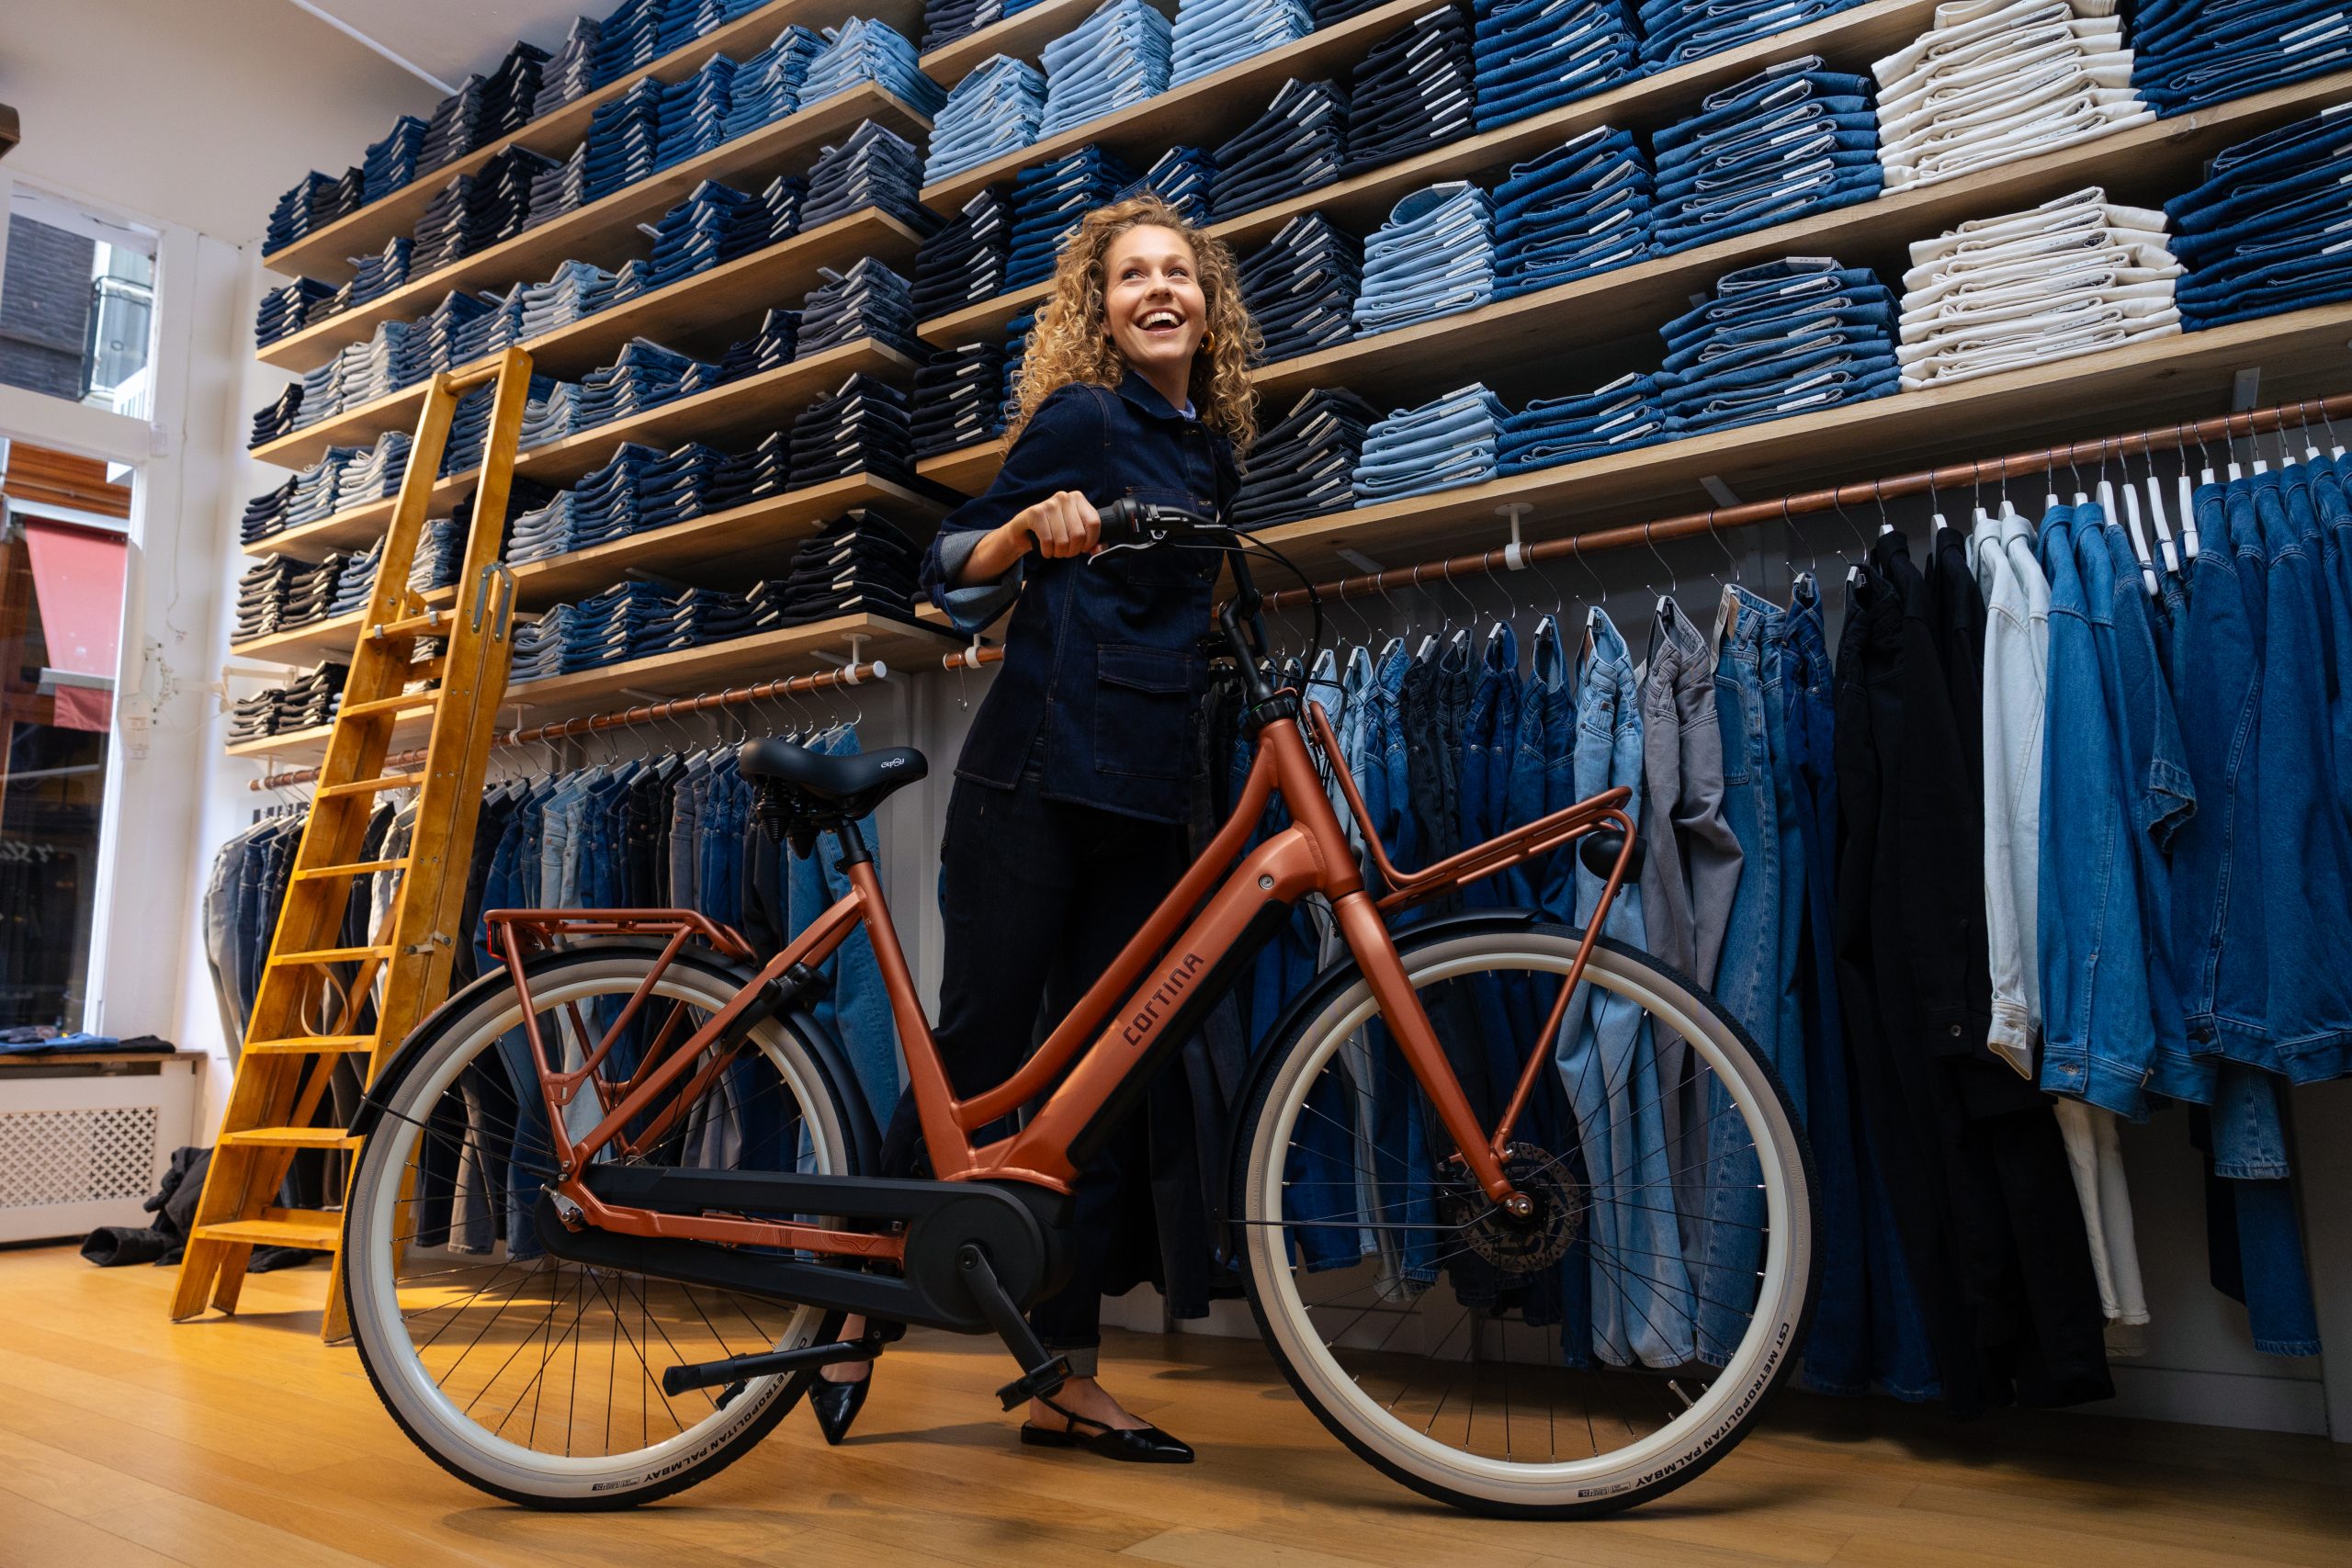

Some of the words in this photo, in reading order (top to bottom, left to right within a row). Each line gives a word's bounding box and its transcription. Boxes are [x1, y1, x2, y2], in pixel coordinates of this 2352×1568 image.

[1122, 953, 1204, 1047] CORTINA
[1776, 1322, 1790, 1349] CST
[710, 1371, 788, 1450] ETROPOLITAN
[1703, 1350, 1779, 1450] METROPOLITAN
[643, 1447, 708, 1483] PALMBAY
[1635, 1446, 1702, 1487] PALMBAY
